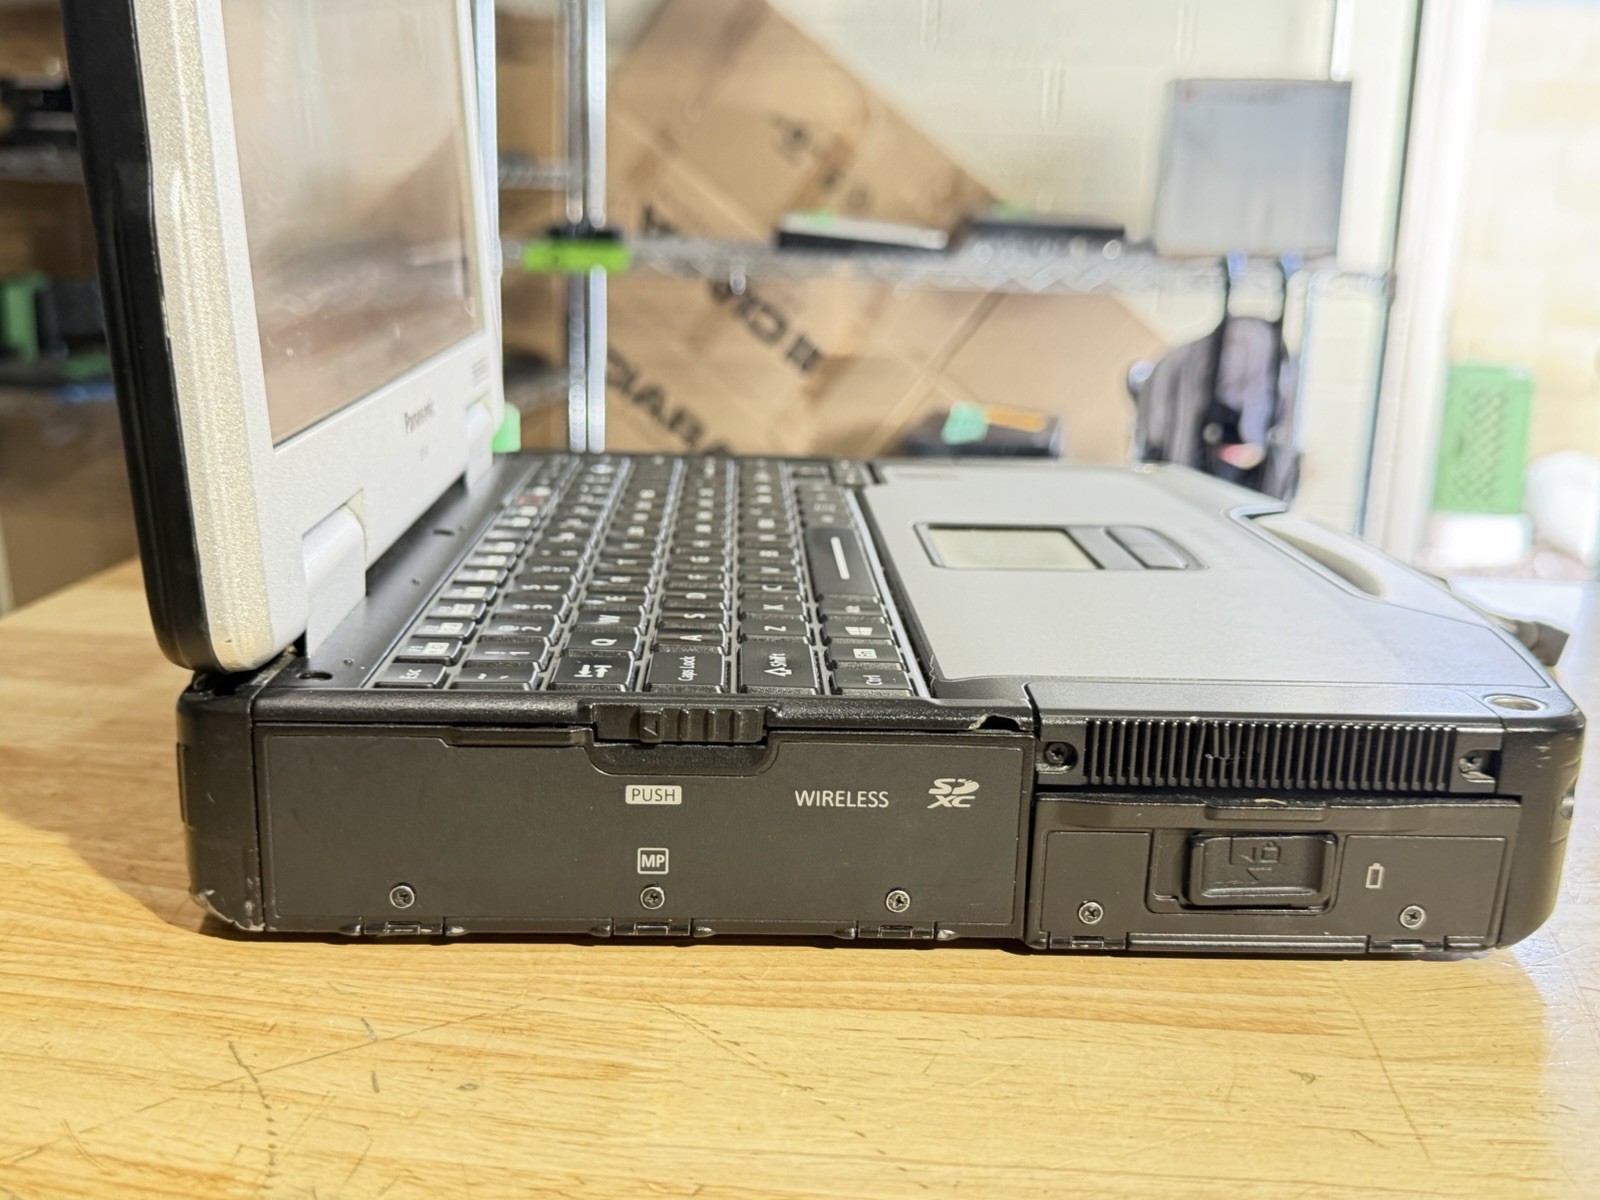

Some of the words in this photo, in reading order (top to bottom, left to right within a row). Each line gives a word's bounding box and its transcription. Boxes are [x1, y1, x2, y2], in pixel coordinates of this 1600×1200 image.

[599, 615, 620, 623] W
[591, 638, 617, 646] Q
[679, 656, 696, 668] Lock
[769, 653, 787, 667] Shift
[399, 668, 422, 680] Esc
[678, 668, 698, 681] Caps
[863, 674, 883, 685] Ctrl
[631, 788, 676, 803] PUSH
[795, 790, 889, 808] WIRELESS
[642, 853, 665, 869] MP
